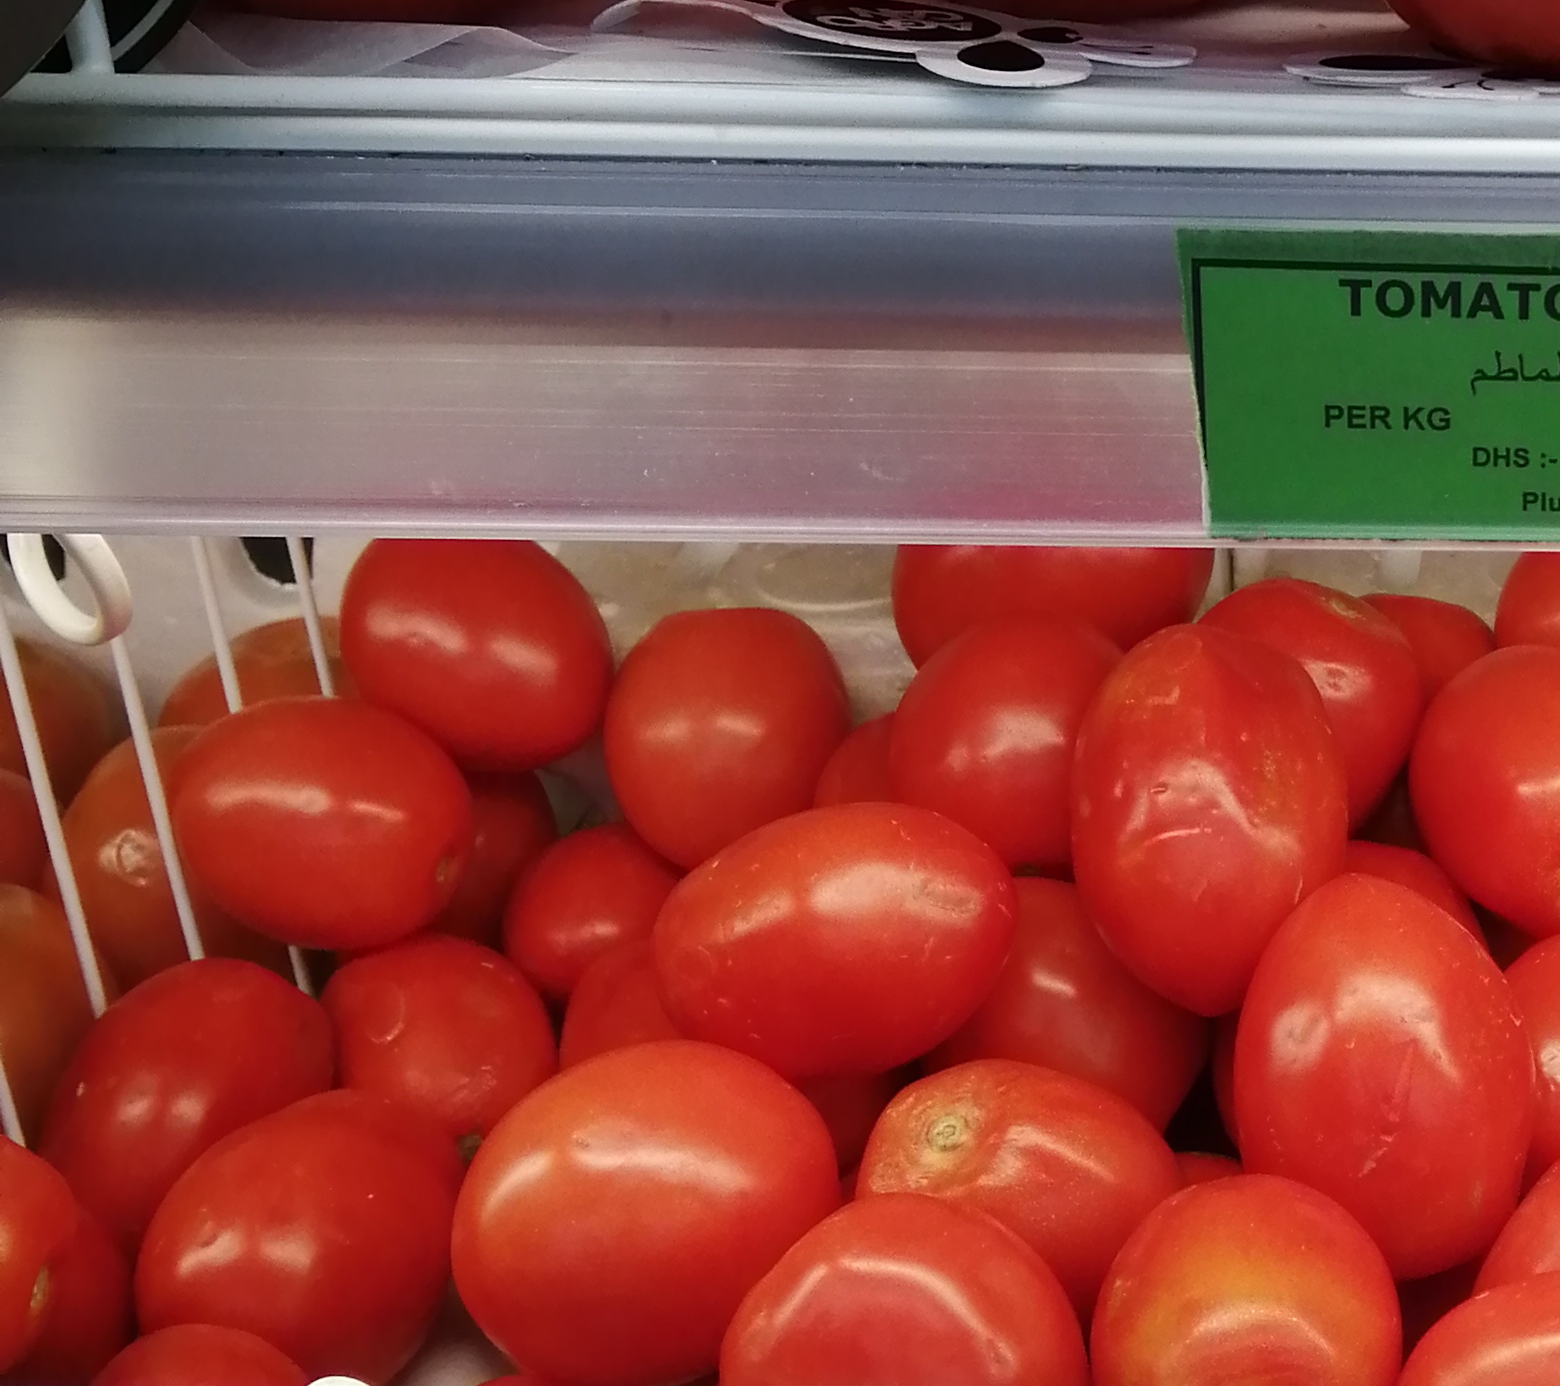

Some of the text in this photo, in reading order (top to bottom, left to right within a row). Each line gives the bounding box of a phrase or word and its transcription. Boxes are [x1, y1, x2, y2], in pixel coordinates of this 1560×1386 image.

[1324, 404, 1451, 432] PER KG
[1472, 446, 1530, 469] DHS
